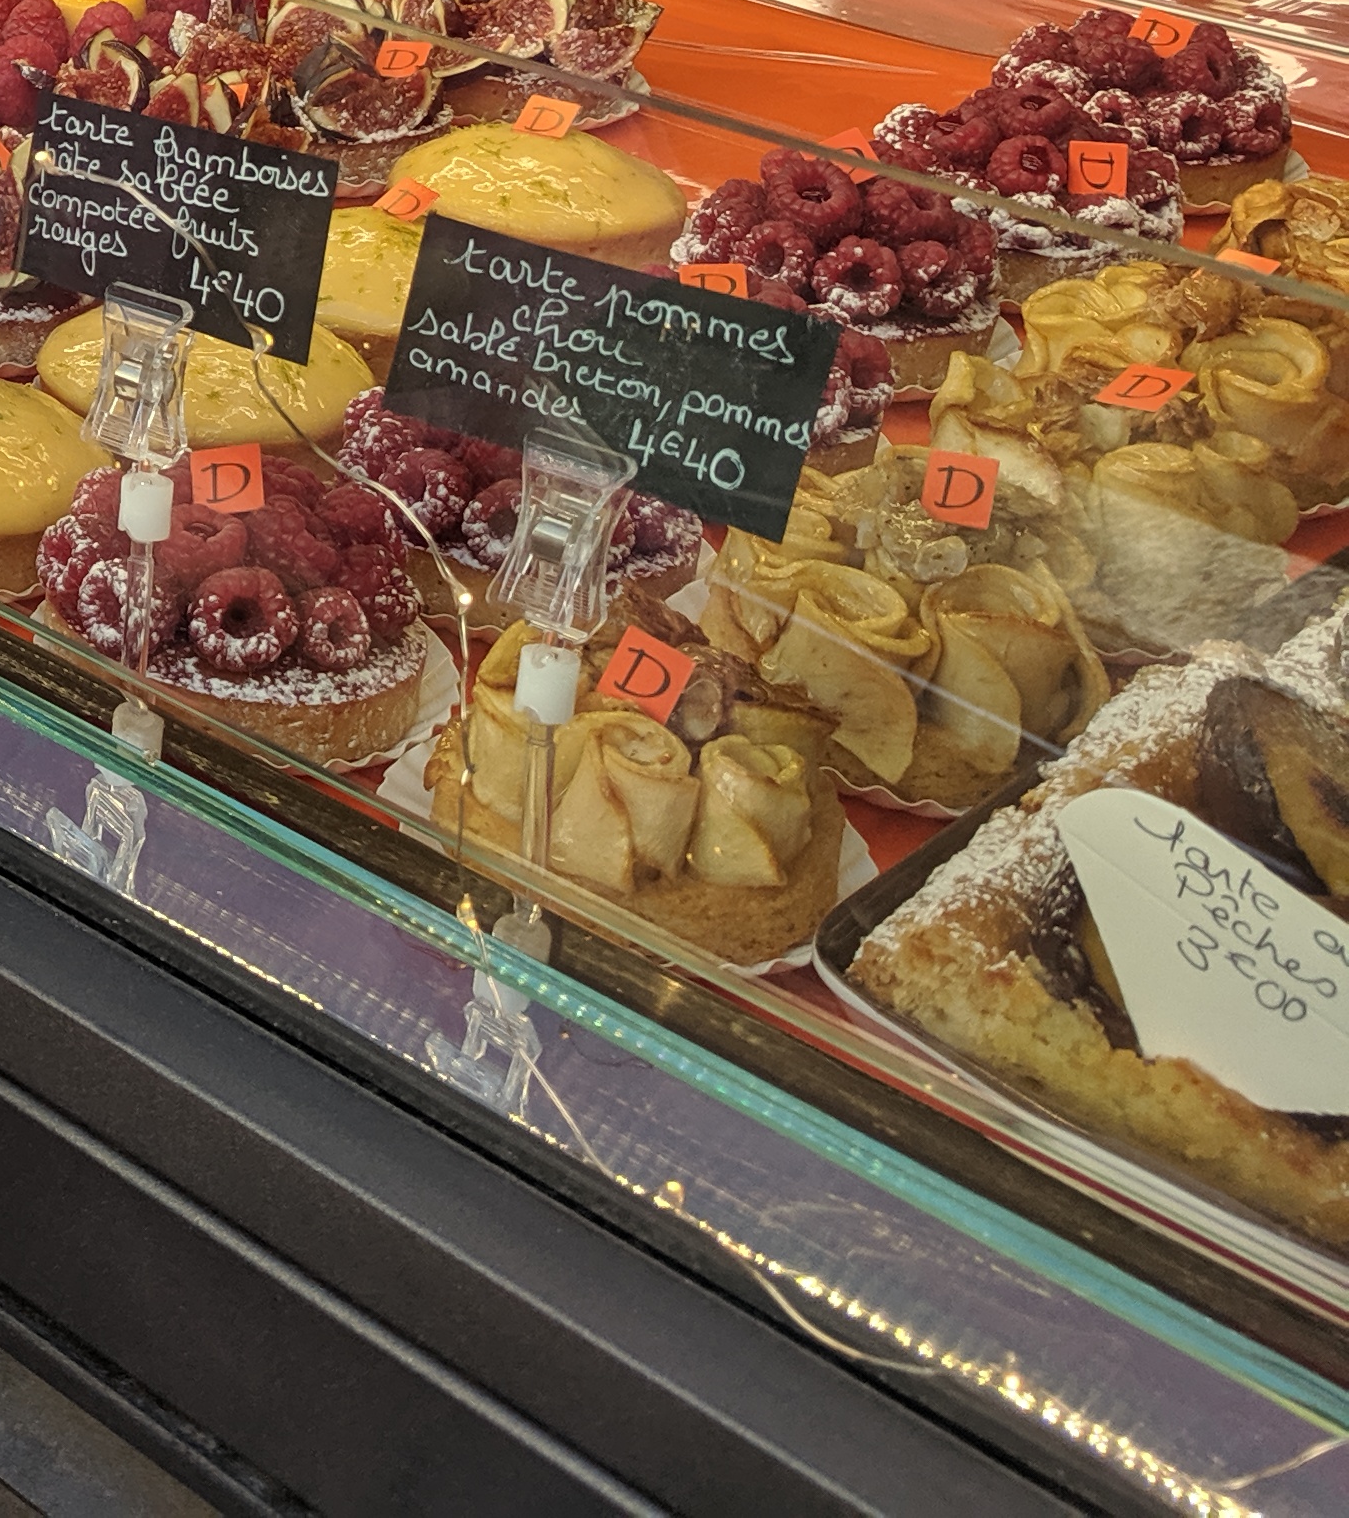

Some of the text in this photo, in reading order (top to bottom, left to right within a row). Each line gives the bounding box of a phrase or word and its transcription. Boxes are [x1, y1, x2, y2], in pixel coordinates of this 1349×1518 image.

[1143, 19, 1180, 47] D
[383, 49, 418, 71] D
[525, 107, 564, 131] D
[38, 102, 330, 198] tarte framboises
[1079, 152, 1115, 189] D
[118, 160, 240, 214] sablée
[382, 189, 421, 214] D
[28, 182, 260, 260] compotée fruits
[29, 215, 128, 277] rouges
[443, 238, 797, 365] tarte pommes
[409, 347, 588, 426] amandes
[1115, 375, 1172, 399] D
[676, 387, 814, 451] pommes
[203, 463, 251, 503] D
[934, 465, 986, 509] D
[612, 648, 670, 698] D
